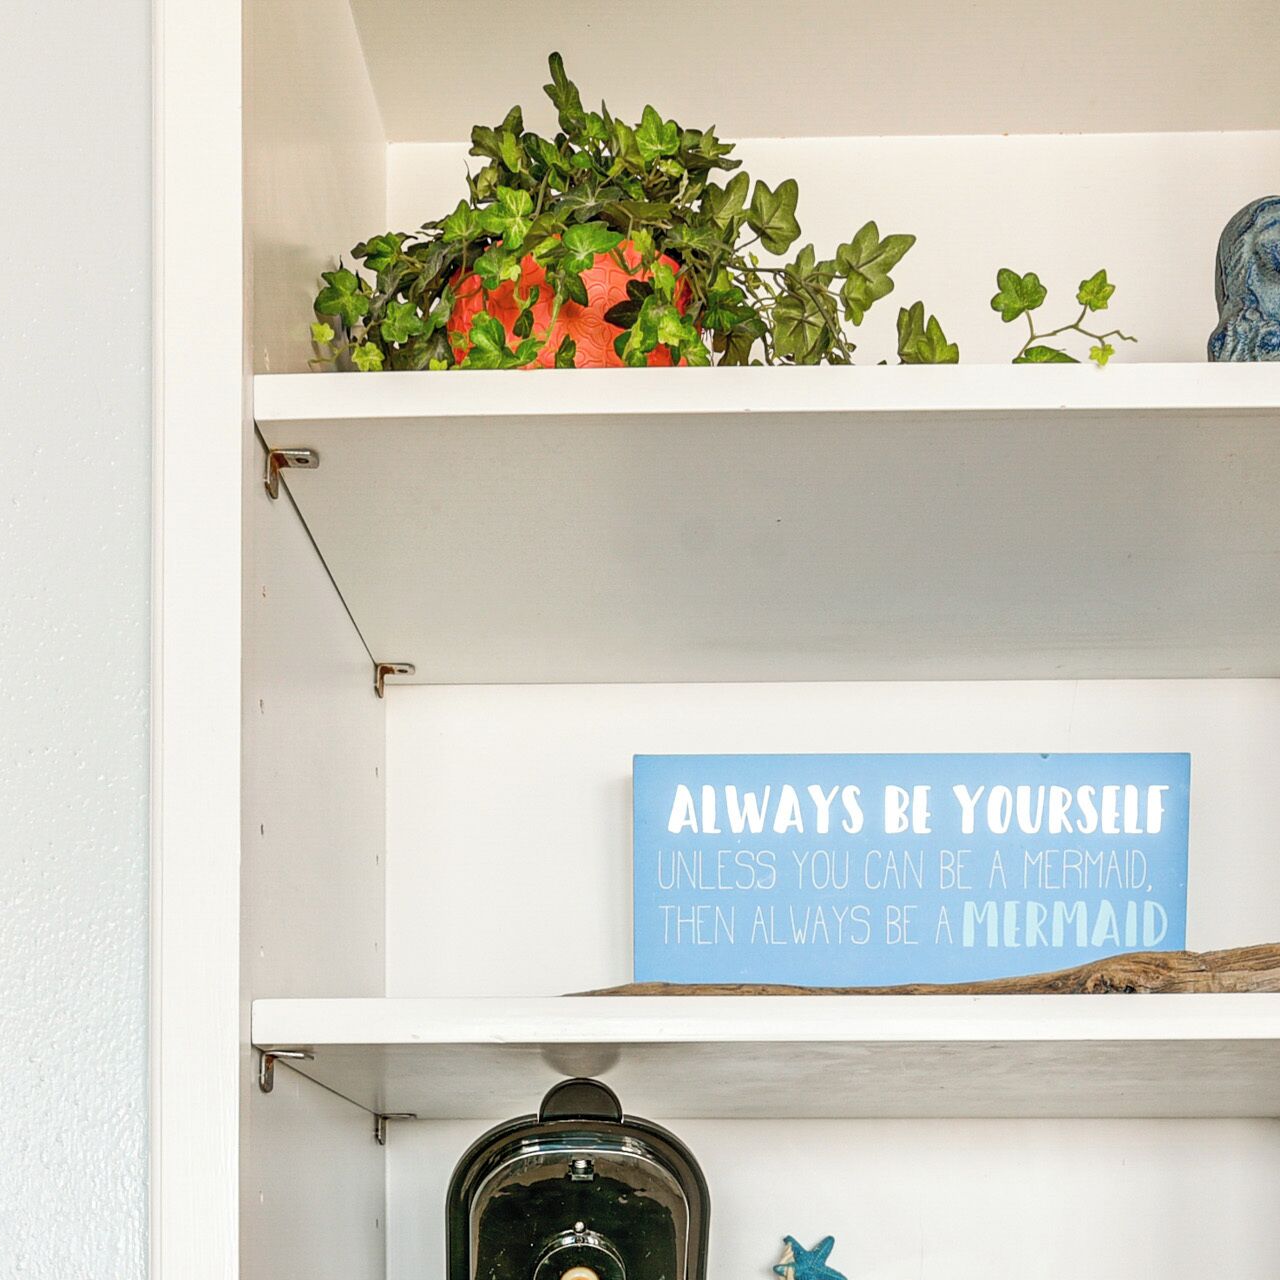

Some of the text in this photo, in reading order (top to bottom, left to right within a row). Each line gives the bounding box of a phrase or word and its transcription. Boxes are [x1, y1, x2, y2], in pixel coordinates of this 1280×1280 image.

[667, 784, 1170, 834] ALWAYS BE YOURSELF
[657, 850, 1153, 892] UNLESS YOU CAN BE A MERMAID,
[658, 899, 1169, 948] THEN ALWAYS BE A MERMAID
